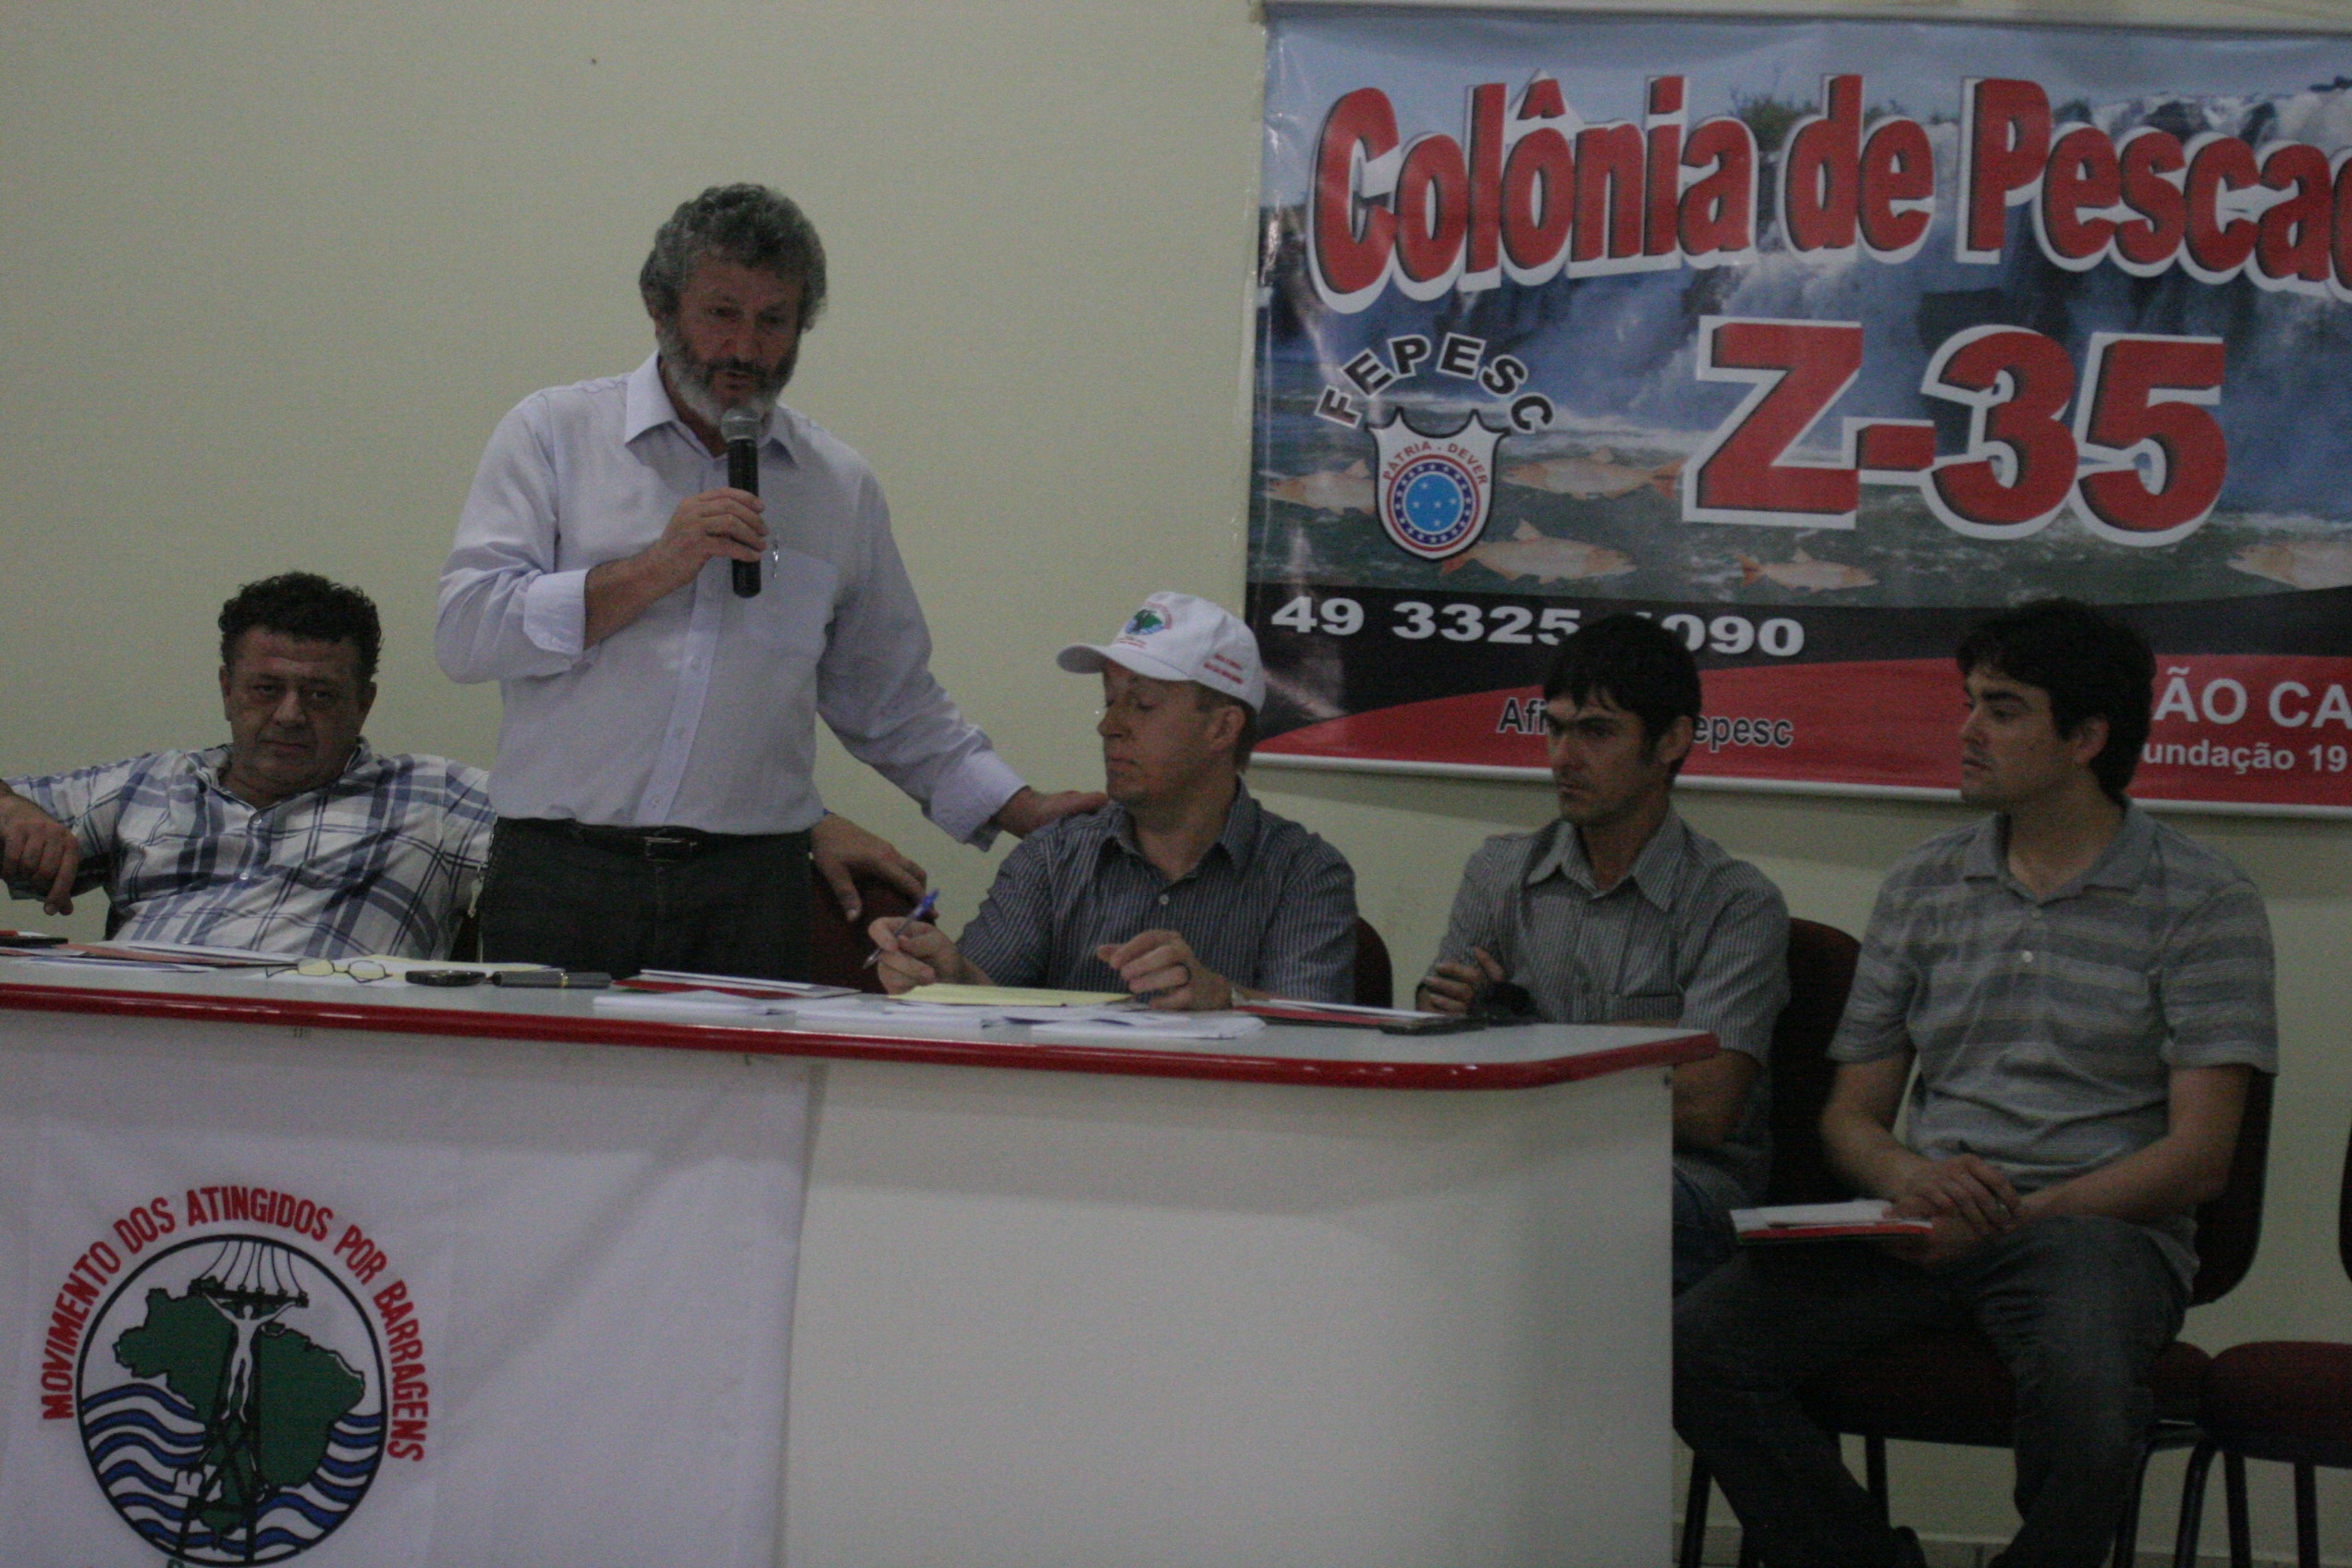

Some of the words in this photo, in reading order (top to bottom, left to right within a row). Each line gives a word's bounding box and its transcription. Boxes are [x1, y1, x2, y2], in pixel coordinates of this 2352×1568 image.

[1306, 68, 1756, 314] Colônia
[1777, 73, 1935, 265] de
[1314, 332, 1554, 433] FEPESC
[1682, 315, 2227, 547] Z-35
[1448, 443, 1488, 484] DEVER
[1271, 595, 1365, 636] 49
[1391, 600, 1582, 646] 3325
[1635, 611, 1805, 657] 090
[2309, 744, 2347, 773] 19
[41, 1241, 122, 1420] MOVIMENTO
[113, 1197, 177, 1255] DOS
[187, 1185, 334, 1242] ATINGIDOS
[333, 1224, 387, 1283] POR
[373, 1280, 429, 1463] BARRAGENS
